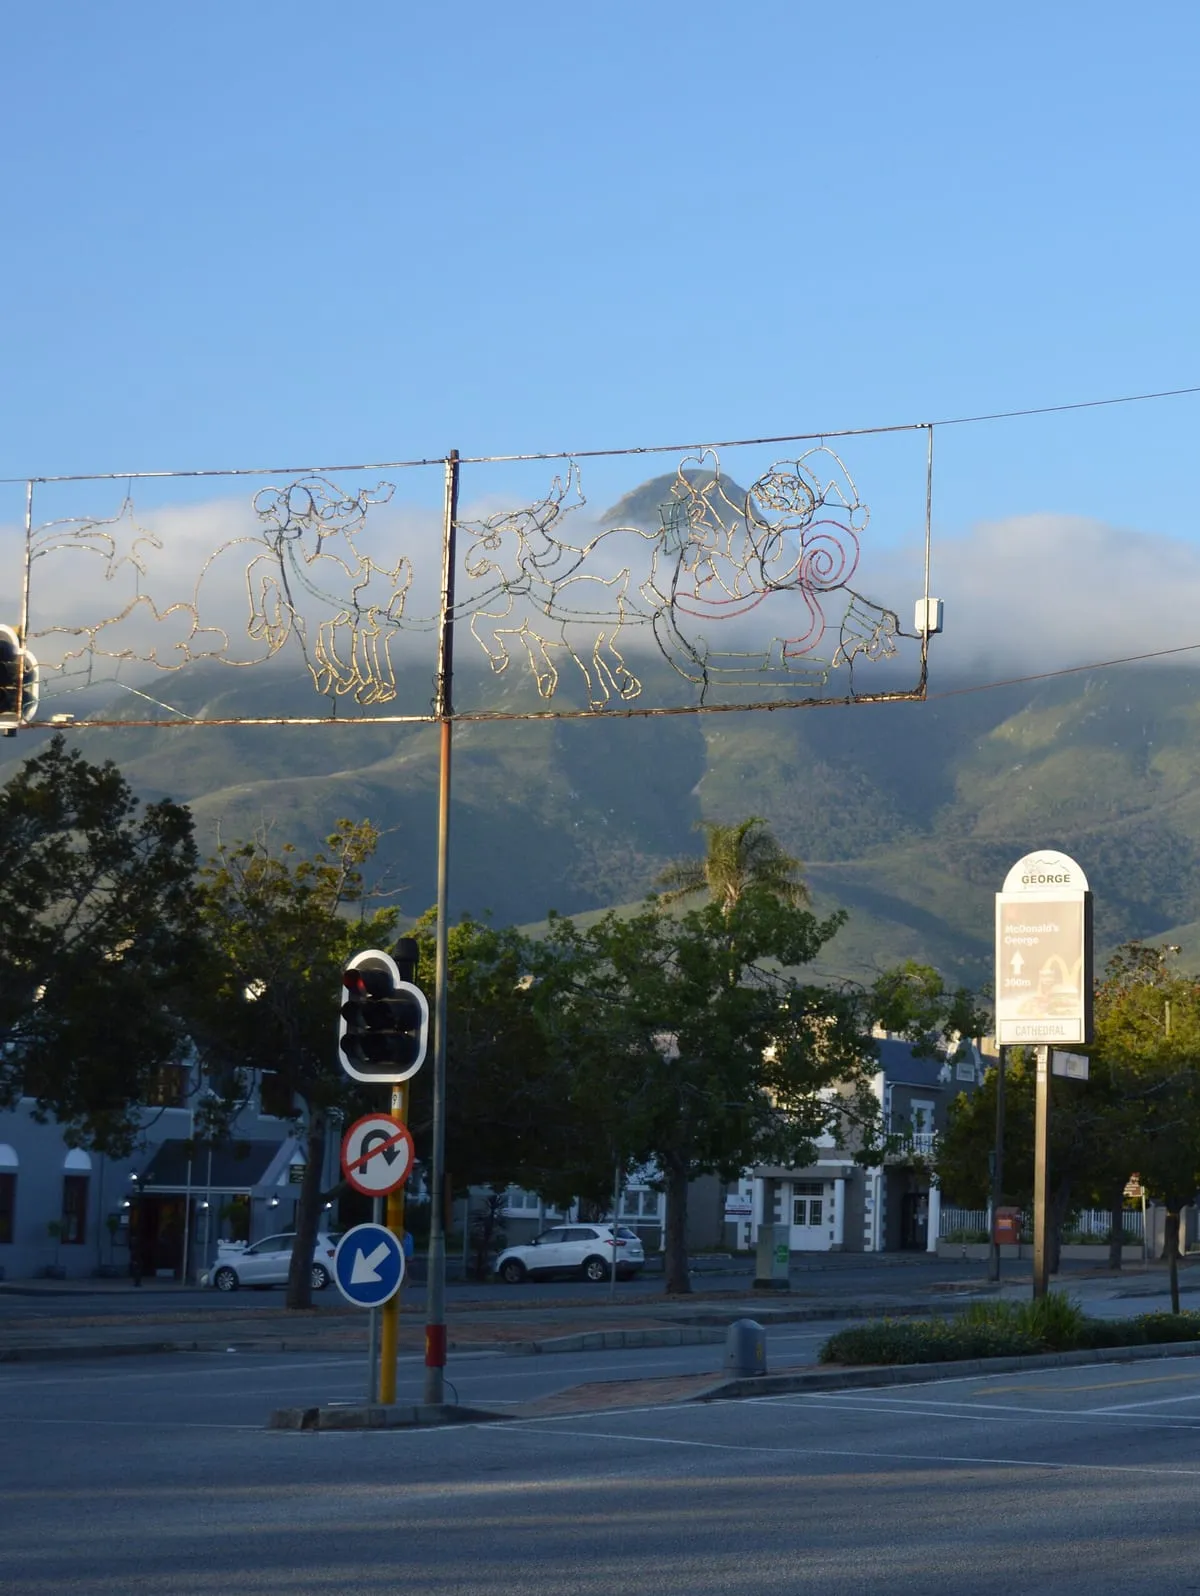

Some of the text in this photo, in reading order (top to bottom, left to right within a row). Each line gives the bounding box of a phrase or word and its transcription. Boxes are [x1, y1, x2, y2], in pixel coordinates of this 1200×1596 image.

[1021, 874, 1071, 884] GEORGE
[1005, 923, 1060, 934] McDonald's
[1004, 935, 1040, 946] George
[1015, 1024, 1066, 1037] CATHEDRAL
